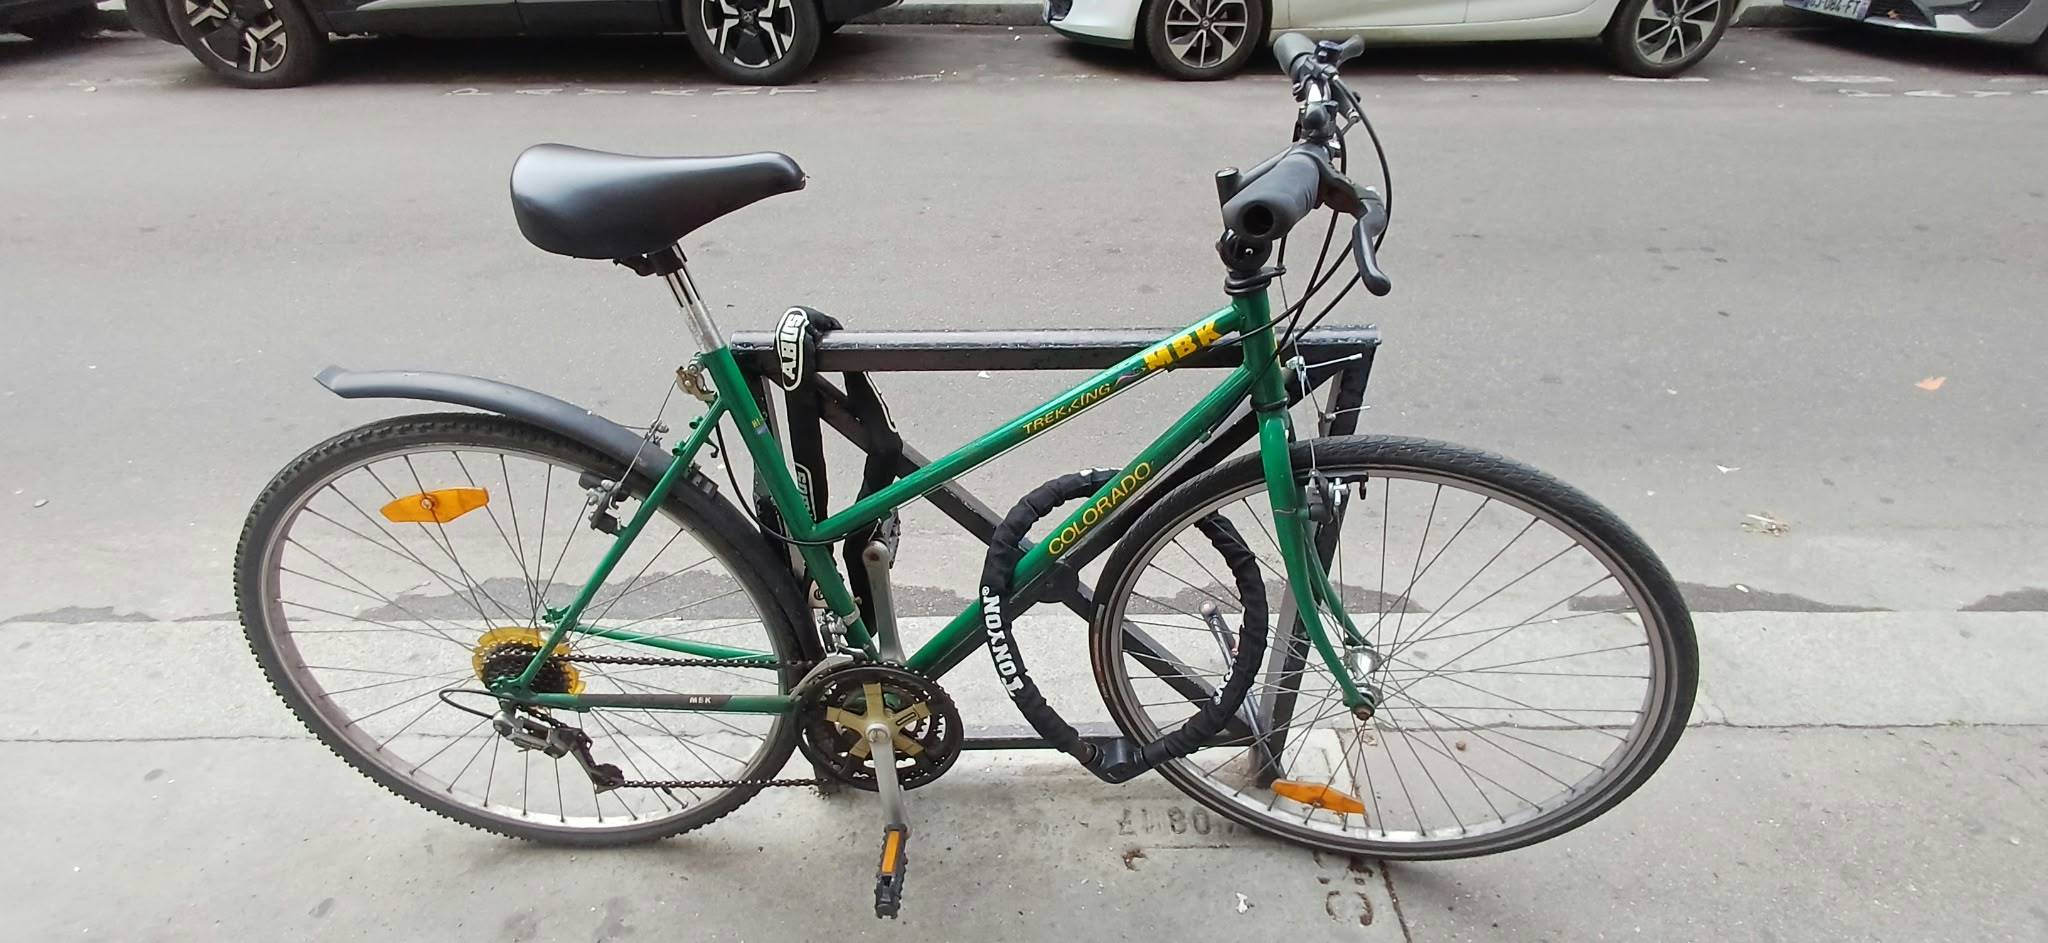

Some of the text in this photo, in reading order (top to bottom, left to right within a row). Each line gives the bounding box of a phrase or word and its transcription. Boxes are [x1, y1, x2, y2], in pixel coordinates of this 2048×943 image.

[780, 312, 802, 381] ABUS
[1143, 319, 1223, 371] MBK
[1048, 462, 1151, 555] COLORADO
[689, 696, 712, 704] MBK
